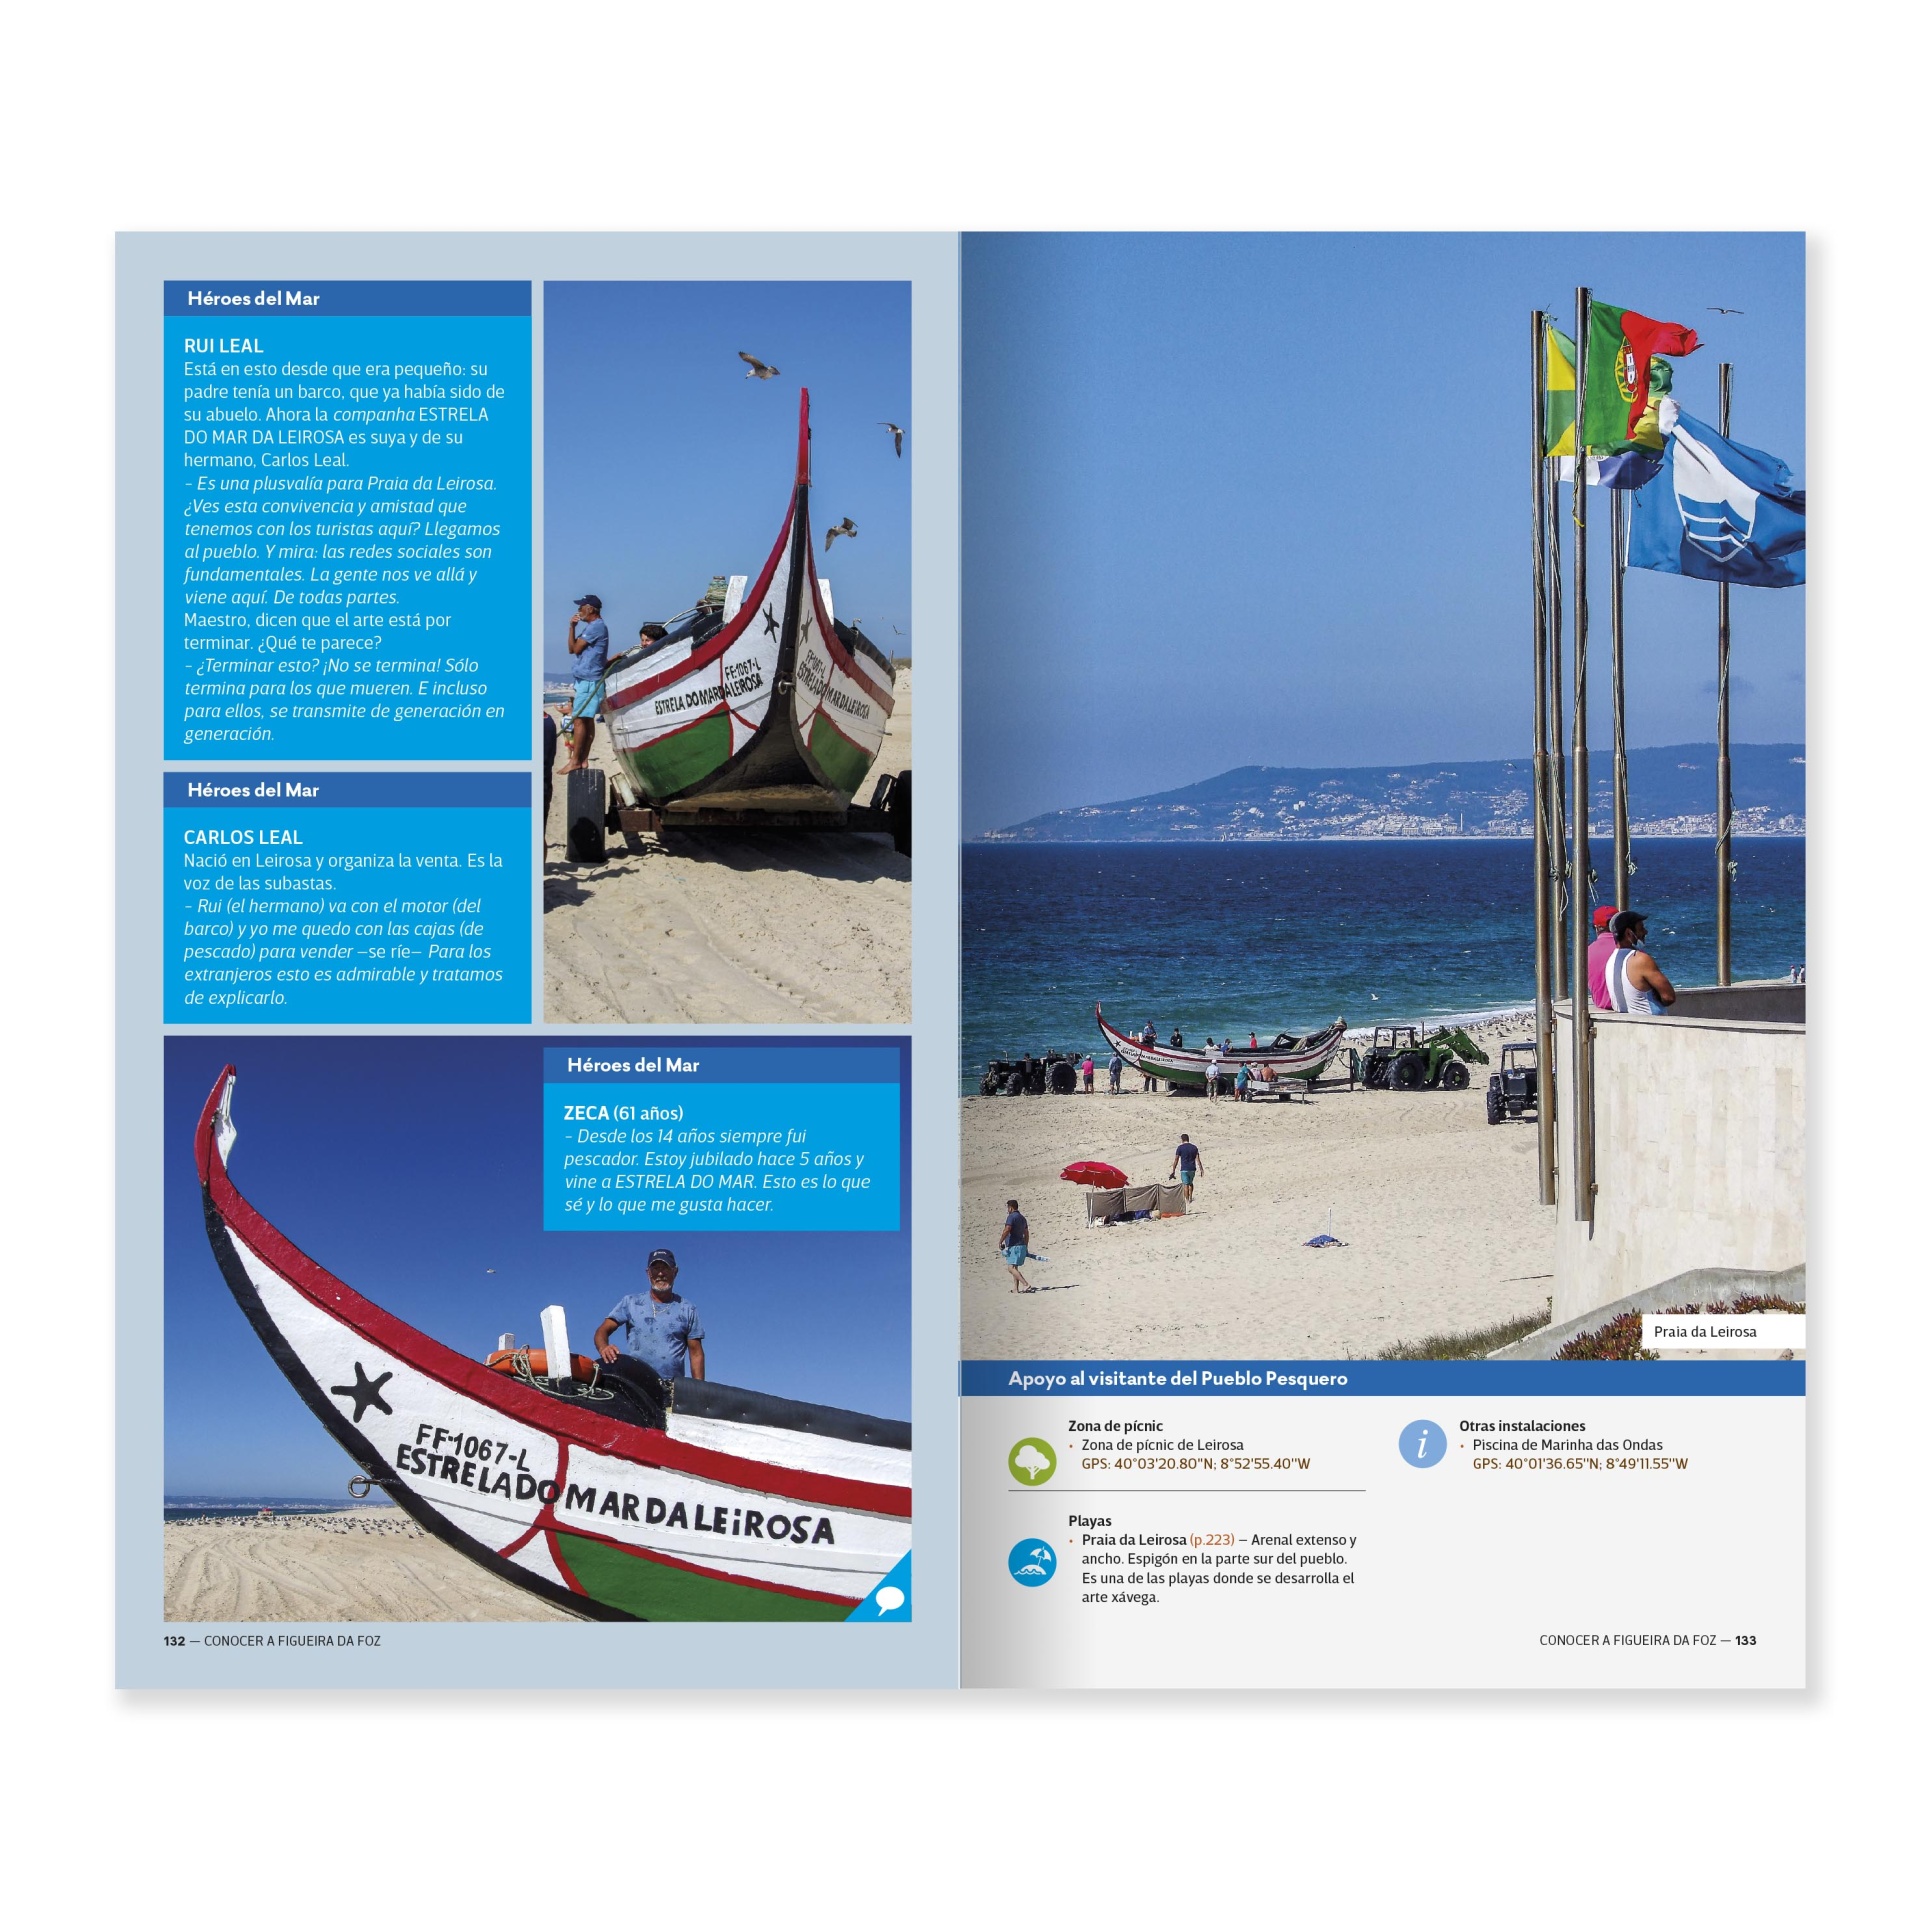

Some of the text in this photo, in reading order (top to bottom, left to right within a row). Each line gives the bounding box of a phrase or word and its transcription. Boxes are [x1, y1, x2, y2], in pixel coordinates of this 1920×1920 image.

[187, 289, 321, 306] Héroes del Mar
[184, 337, 265, 354] RUI LEAL
[184, 360, 488, 380] Está en esto desde que era pequeño: su
[183, 406, 489, 426] su abuelo. Ahora la companha ESTRELA
[183, 451, 350, 469] hermano, Carlos Leal.
[183, 635, 383, 654] terminar. ¿Qué te parece?
[183, 726, 274, 745] generación.
[187, 781, 320, 798] Héroes del Mar
[183, 829, 304, 845] CARLOS LEAL
[183, 852, 504, 872] Nació en Leirosa y organiza la venta. Es la
[183, 874, 337, 891] voz de las subastas.
[567, 1056, 700, 1073] Héroes del Mar
[563, 1104, 684, 1123] ZECA (61 años)
[565, 1173, 871, 1193] vine a ESTRELA DO MAR. Esto es lo que
[1654, 1324, 1758, 1338] Praia da Leirosa
[1007, 1369, 1349, 1391] Apoyo al visitante del Pueblo Pesquero
[1068, 1419, 1164, 1436] Zona de pícnic
[1459, 1419, 1587, 1432] Otras instalaciones
[1081, 1438, 1245, 1454] Zona de pícnic de Leirosa
[1473, 1438, 1664, 1451] Piscina de Marinha das Ondas
[1081, 1457, 1111, 1470] GPS:
[1472, 1457, 1502, 1470] GPS:
[1068, 1514, 1113, 1531] Playas
[1082, 1533, 1117, 1546] Praia
[1118, 1533, 1137, 1546] da
[1138, 1533, 1188, 1546] Leirosa
[1189, 1532, 1235, 1549] (p.223)
[1250, 1533, 1293, 1546] Arenal
[1295, 1535, 1347, 1546] extenso
[1349, 1536, 1358, 1549] y
[1081, 1551, 1348, 1568] ancho. Espigón en la parte sur del pueblo.
[1082, 1571, 1355, 1588] Es una de las playas donde se desarrolla el
[1081, 1590, 1160, 1607] arte xávega.
[163, 1635, 186, 1647] 132
[204, 1635, 264, 1647] CONOCER
[266, 1635, 275, 1647] A
[278, 1635, 335, 1647] FIGUEIRA
[337, 1635, 355, 1647] DA
[357, 1635, 381, 1647] FOZ
[1539, 1634, 1600, 1646] CONOCER
[1601, 1634, 1611, 1646] A
[1613, 1634, 1671, 1646] FIGUEIRA
[1673, 1634, 1690, 1646] DA
[1692, 1634, 1717, 1646] FOZ
[1734, 1635, 1757, 1646] 133
